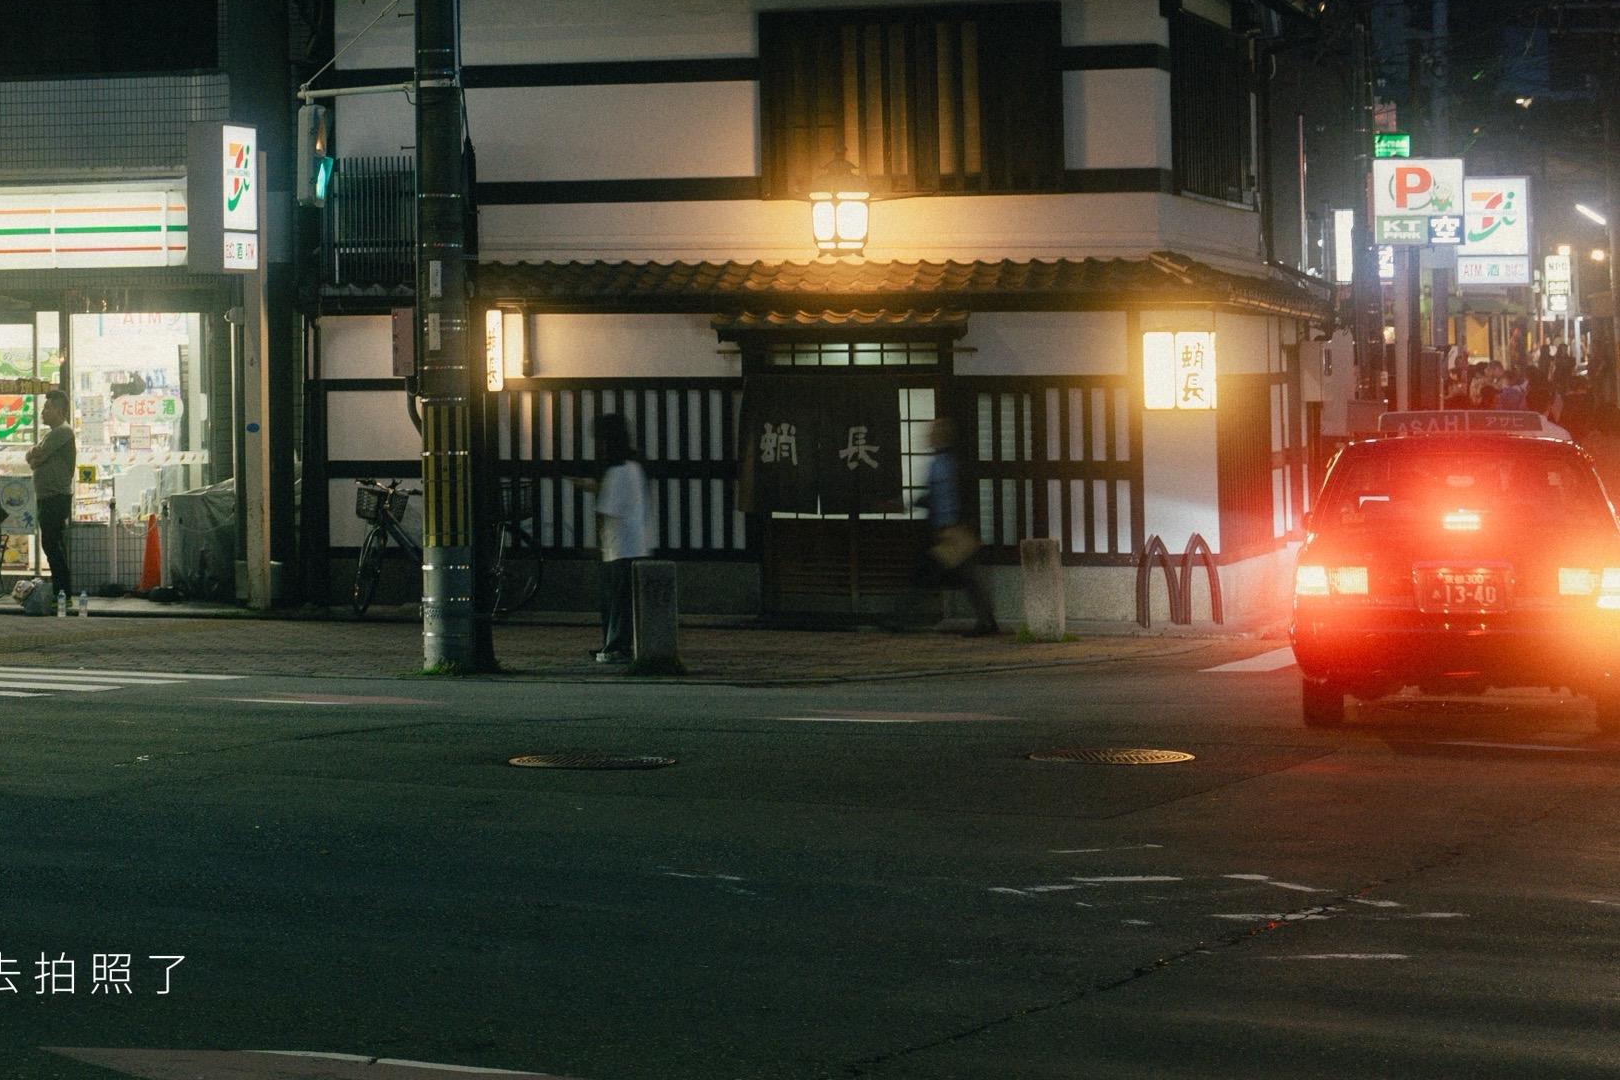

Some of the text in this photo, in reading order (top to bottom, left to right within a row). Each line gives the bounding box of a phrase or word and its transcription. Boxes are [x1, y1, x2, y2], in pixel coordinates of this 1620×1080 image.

[1395, 167, 1432, 209] P
[1383, 220, 1421, 232] KT
[1430, 215, 1461, 243] 空
[122, 399, 176, 416] たばこ 酒
